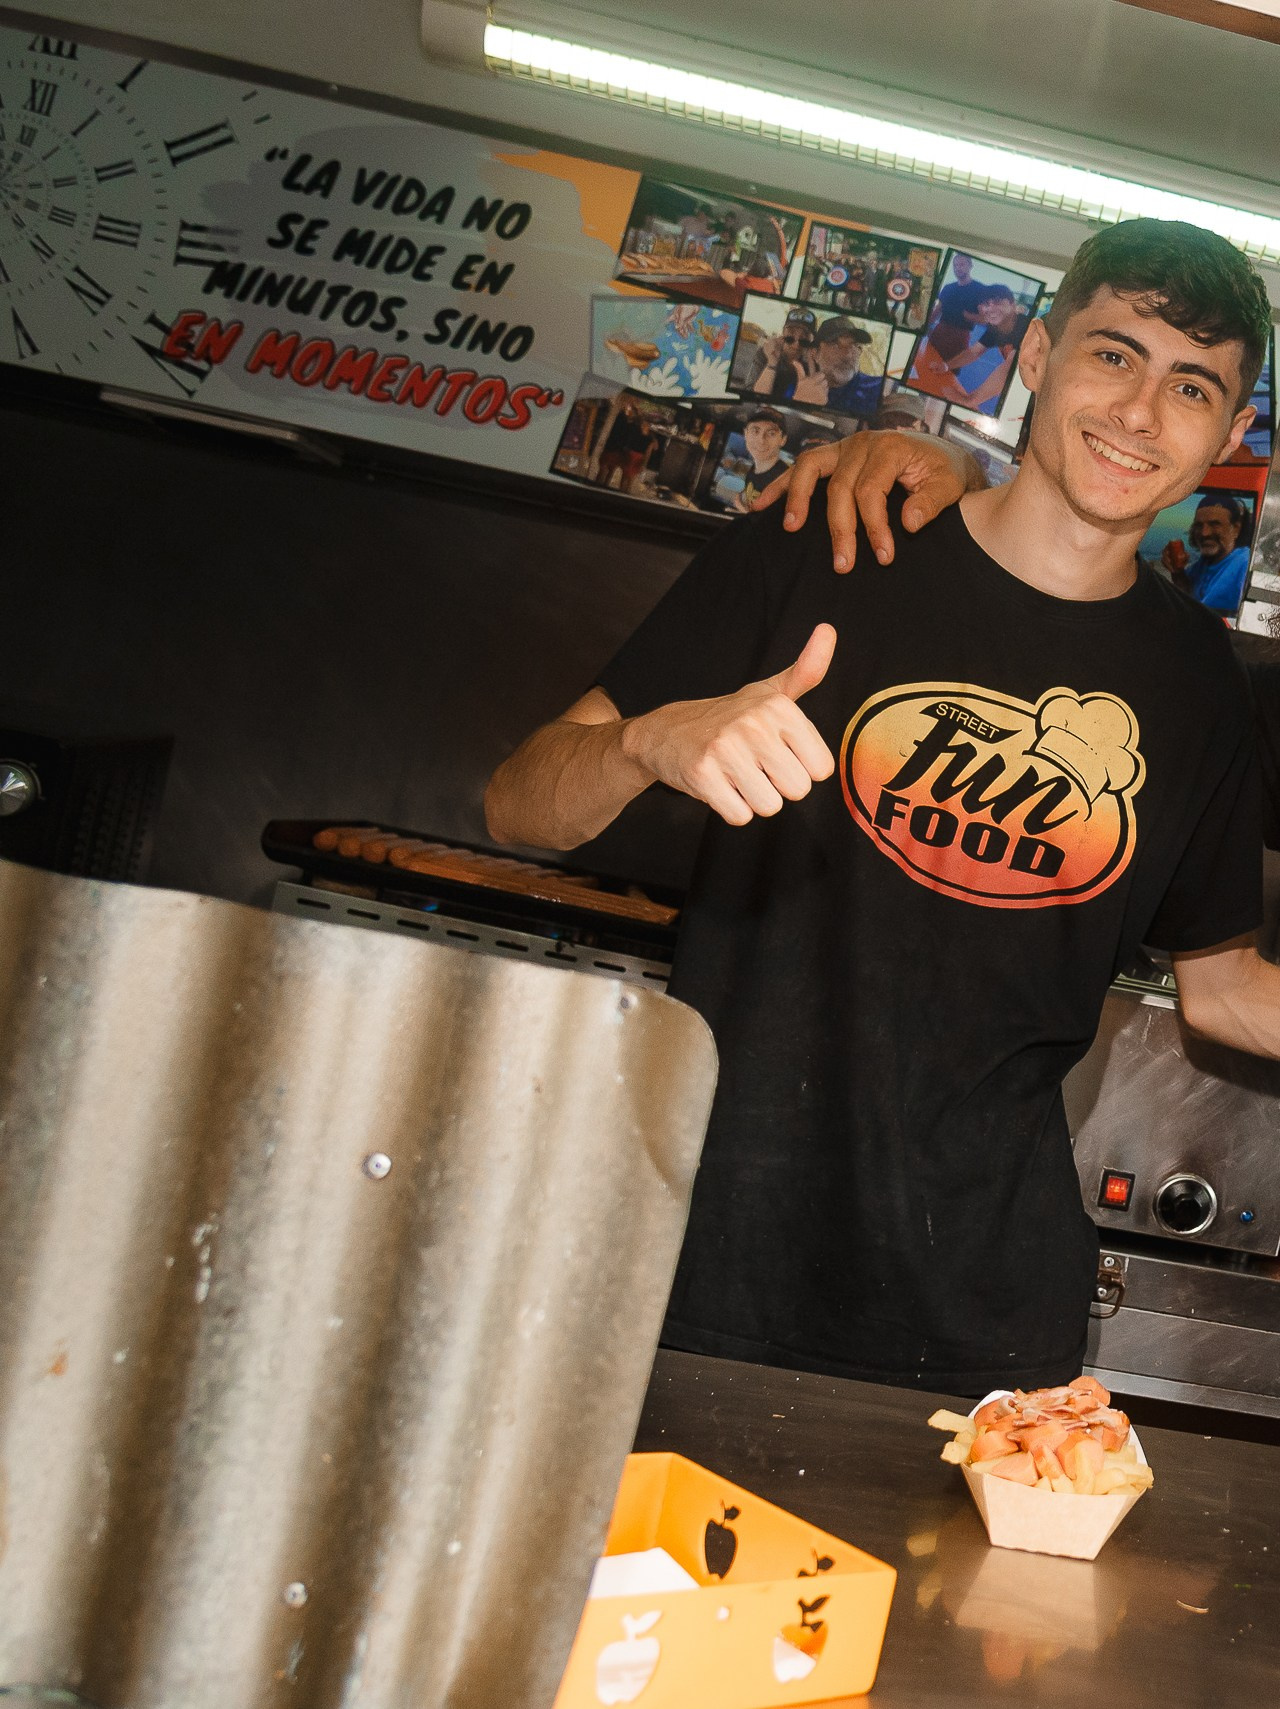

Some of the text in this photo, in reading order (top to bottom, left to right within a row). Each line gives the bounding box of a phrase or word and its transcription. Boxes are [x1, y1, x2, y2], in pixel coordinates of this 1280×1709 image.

[351, 166, 456, 227] VIDA
[462, 196, 533, 241] NO
[266, 212, 516, 296] SE MIDE EN
[162, 309, 245, 366] EN
[202, 260, 536, 363] MINUTOS, SINO
[935, 702, 1000, 740] STREET
[872, 787, 1067, 879] FOOD
